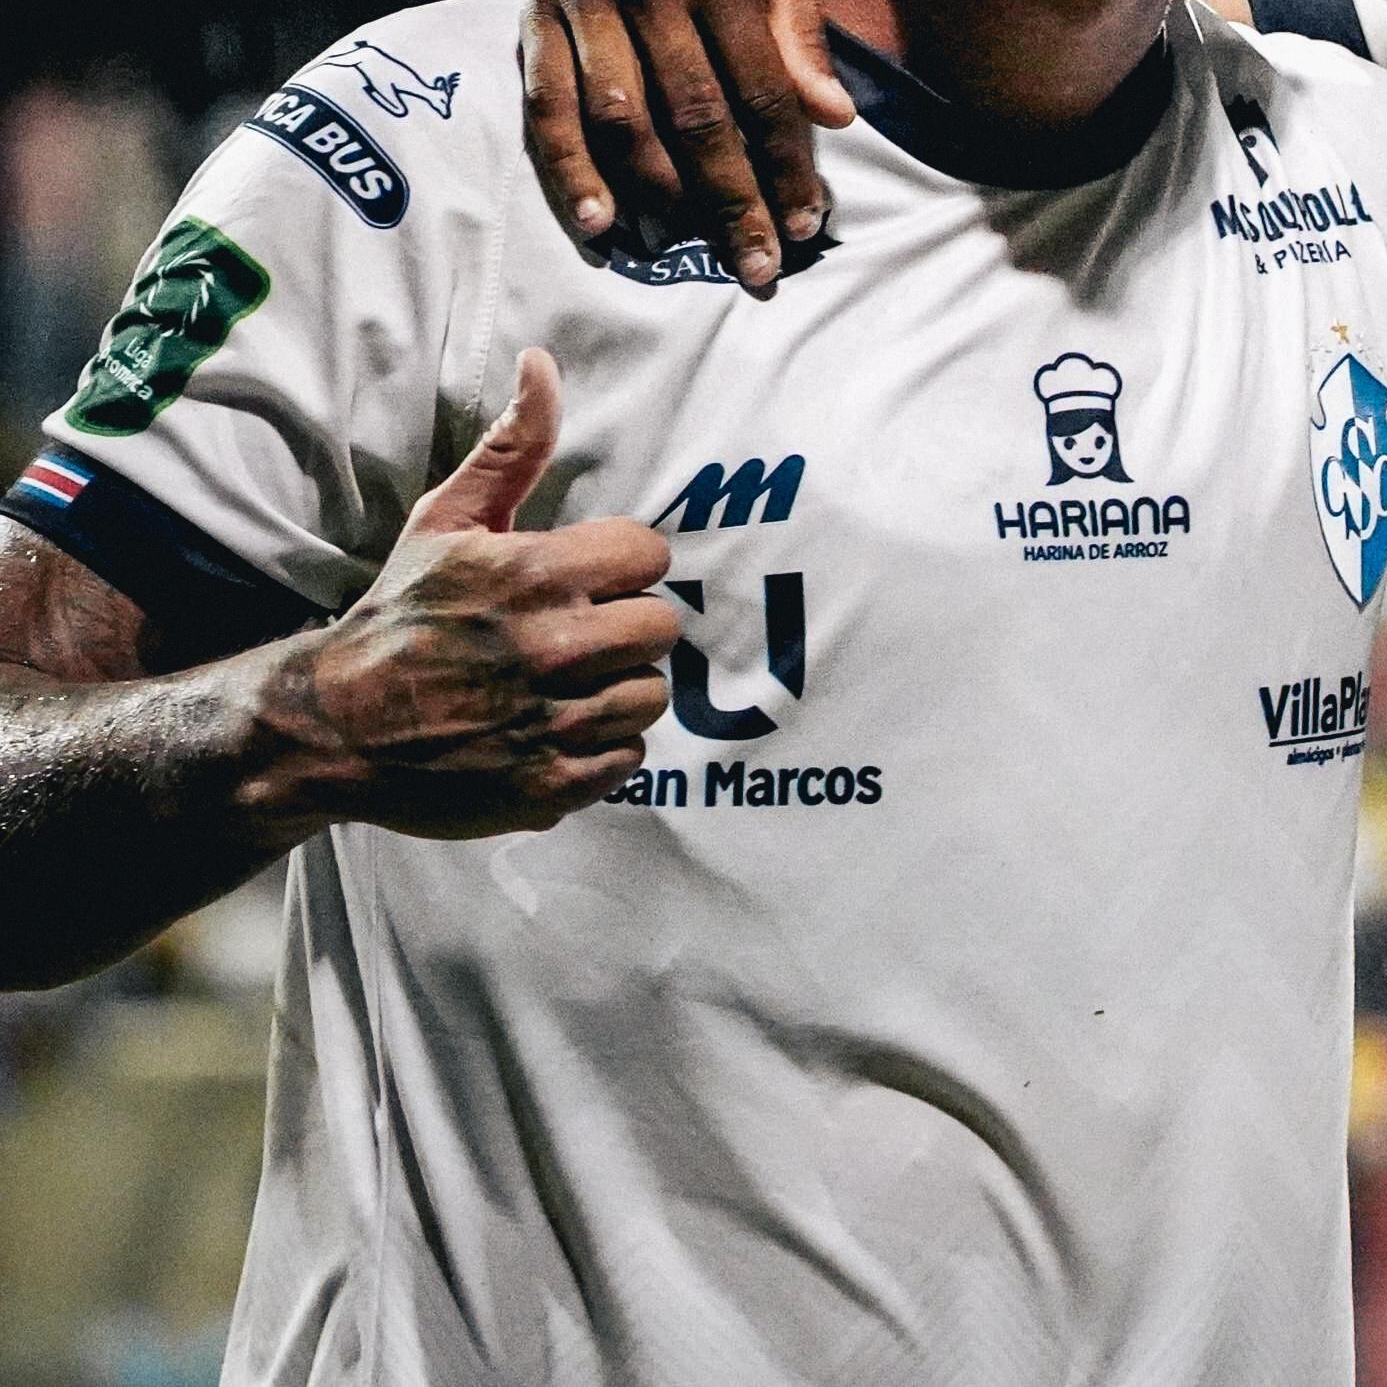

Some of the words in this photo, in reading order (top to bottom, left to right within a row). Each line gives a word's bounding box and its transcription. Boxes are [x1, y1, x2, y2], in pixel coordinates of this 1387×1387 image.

[302, 121, 393, 200] BUS
[124, 336, 154, 369] Liga
[993, 495, 1191, 539] HARIANA
[1024, 544, 1085, 562] HARINA
[1089, 543, 1110, 560] DE
[1113, 541, 1168, 559] ARROZ
[704, 760, 882, 807] Marcos
